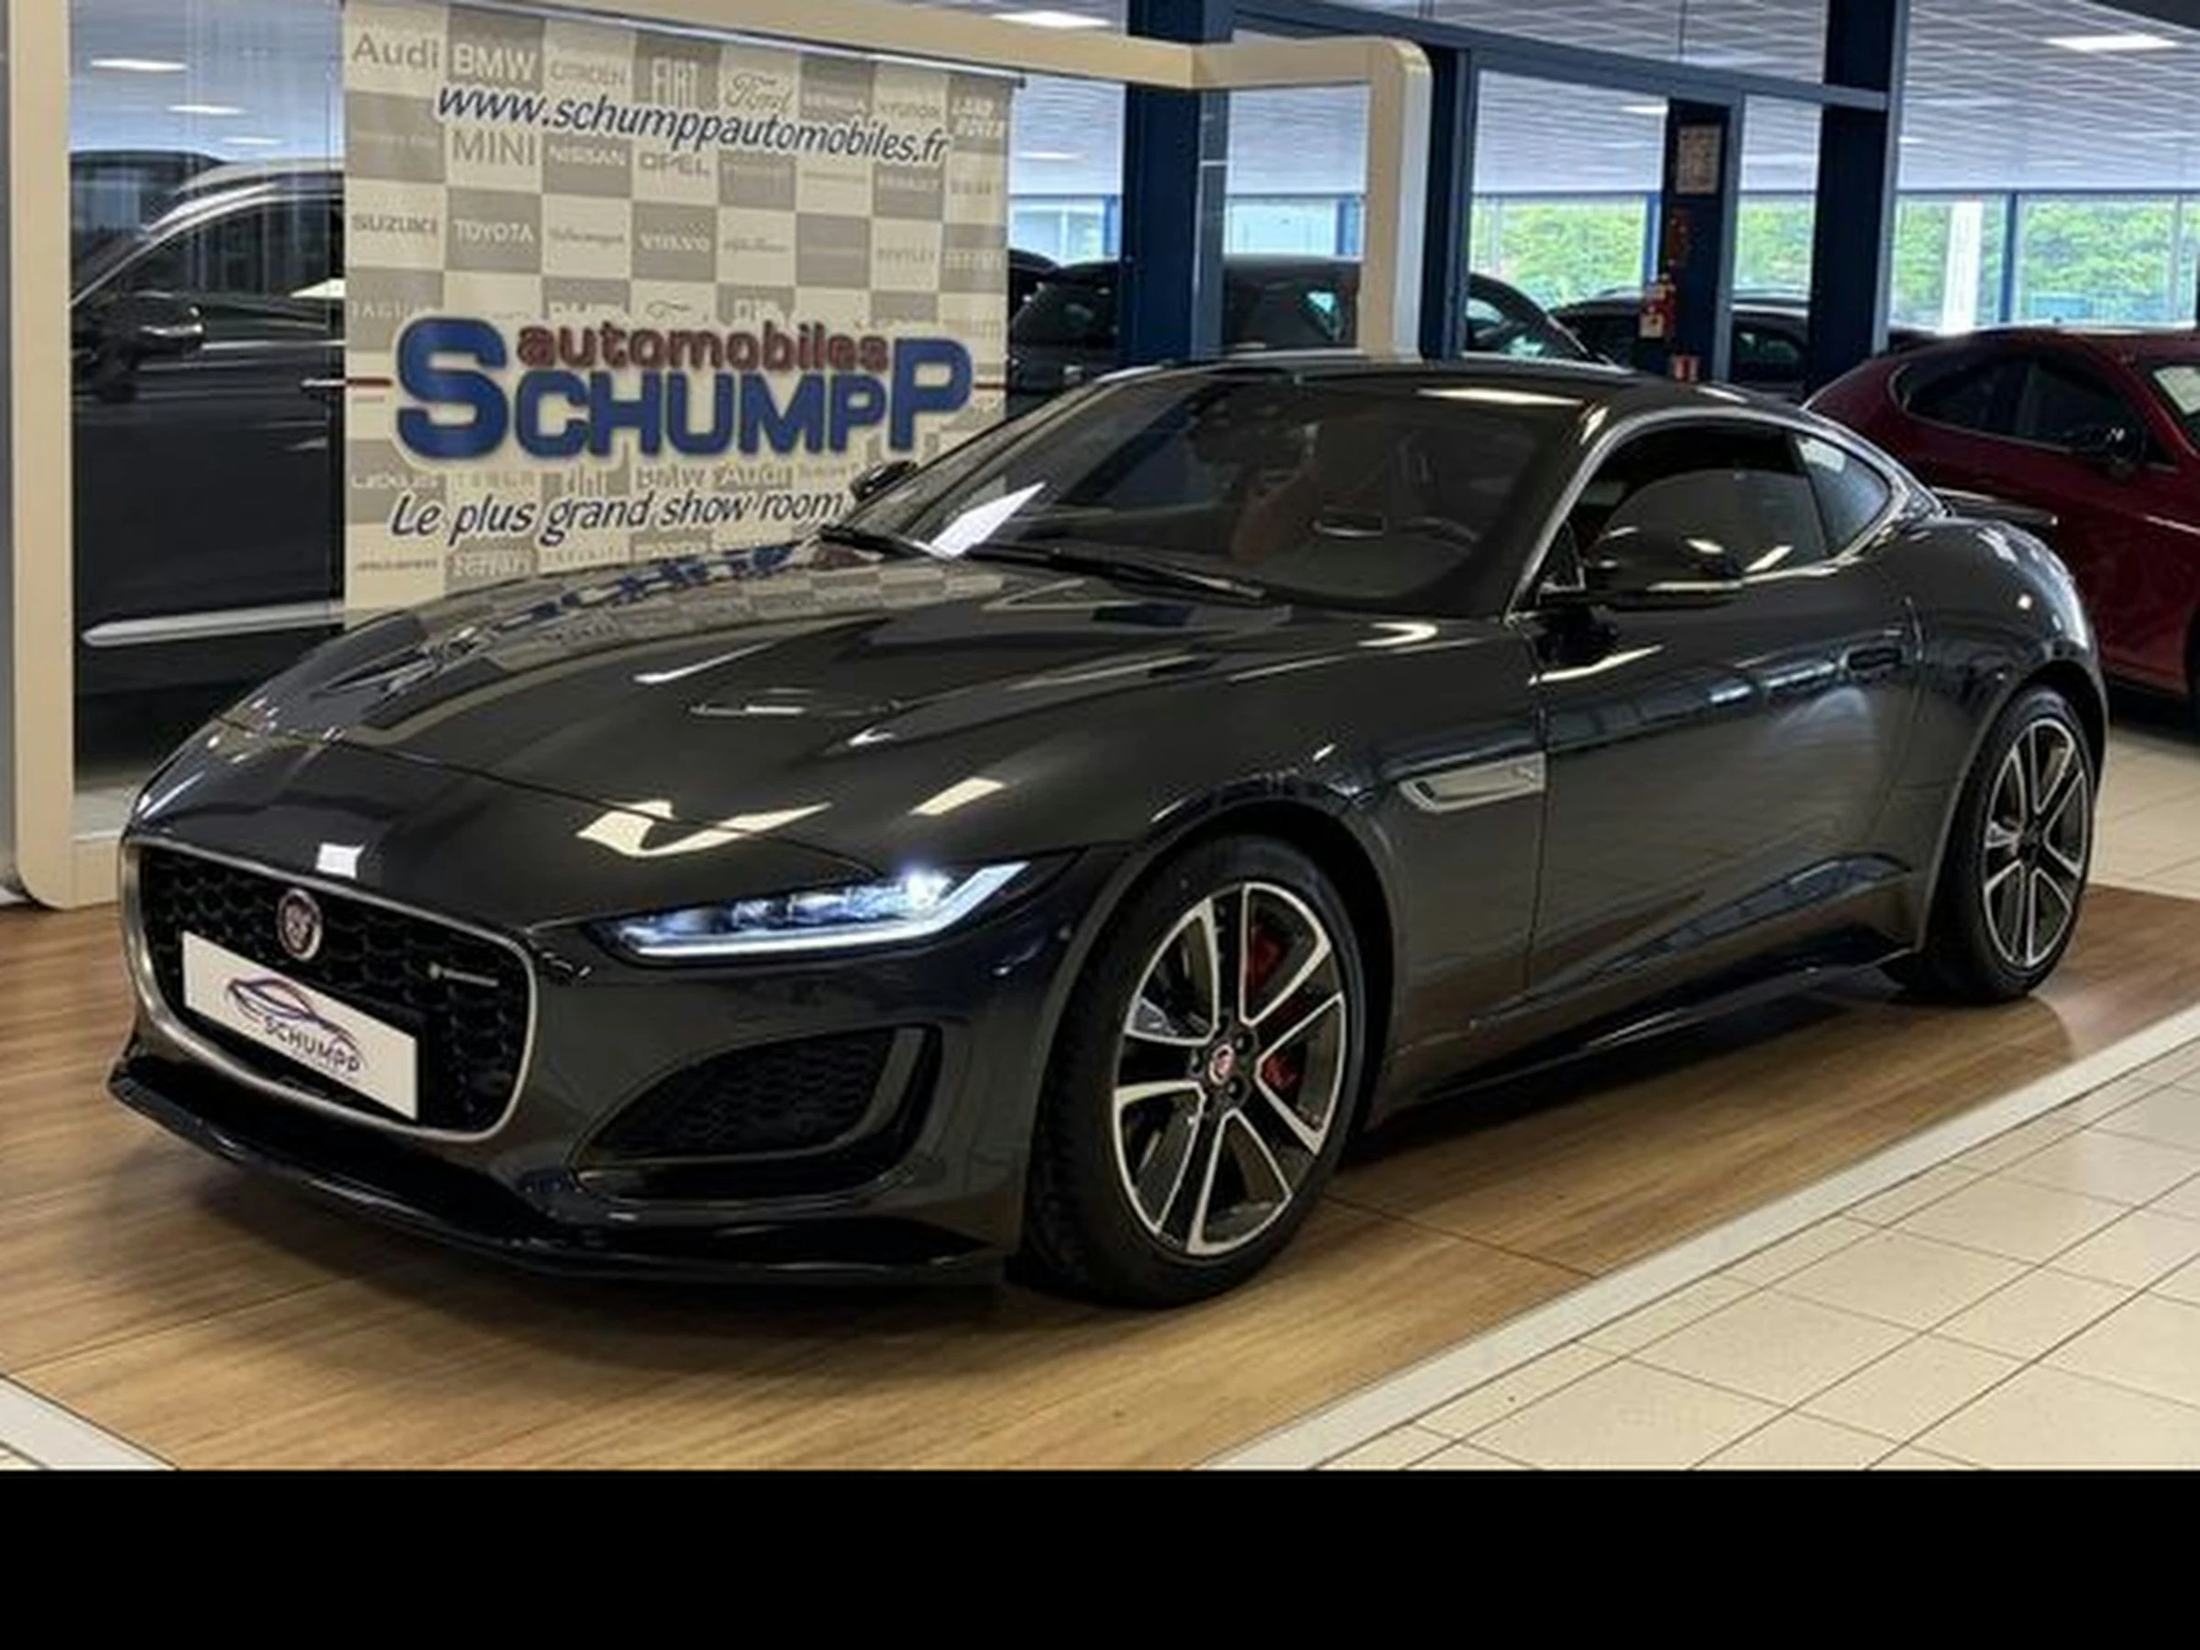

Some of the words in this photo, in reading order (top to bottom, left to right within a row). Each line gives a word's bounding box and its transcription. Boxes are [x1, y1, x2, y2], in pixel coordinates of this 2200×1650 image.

[353, 33, 439, 69] Audi
[454, 44, 536, 80] BMW
[725, 73, 793, 110] Ford
[439, 87, 948, 163] www.schumppautomobiles.fr
[453, 133, 534, 165] MINI
[352, 214, 438, 236] SUZUKI
[453, 219, 534, 243] TOYOTA
[516, 320, 888, 370] automobiles
[391, 495, 442, 537] Le
[447, 493, 536, 546] plus
[540, 490, 654, 547] grand
[660, 489, 752, 526] show
[758, 490, 844, 521] room
[264, 1015, 360, 1073] SCHUMPP
